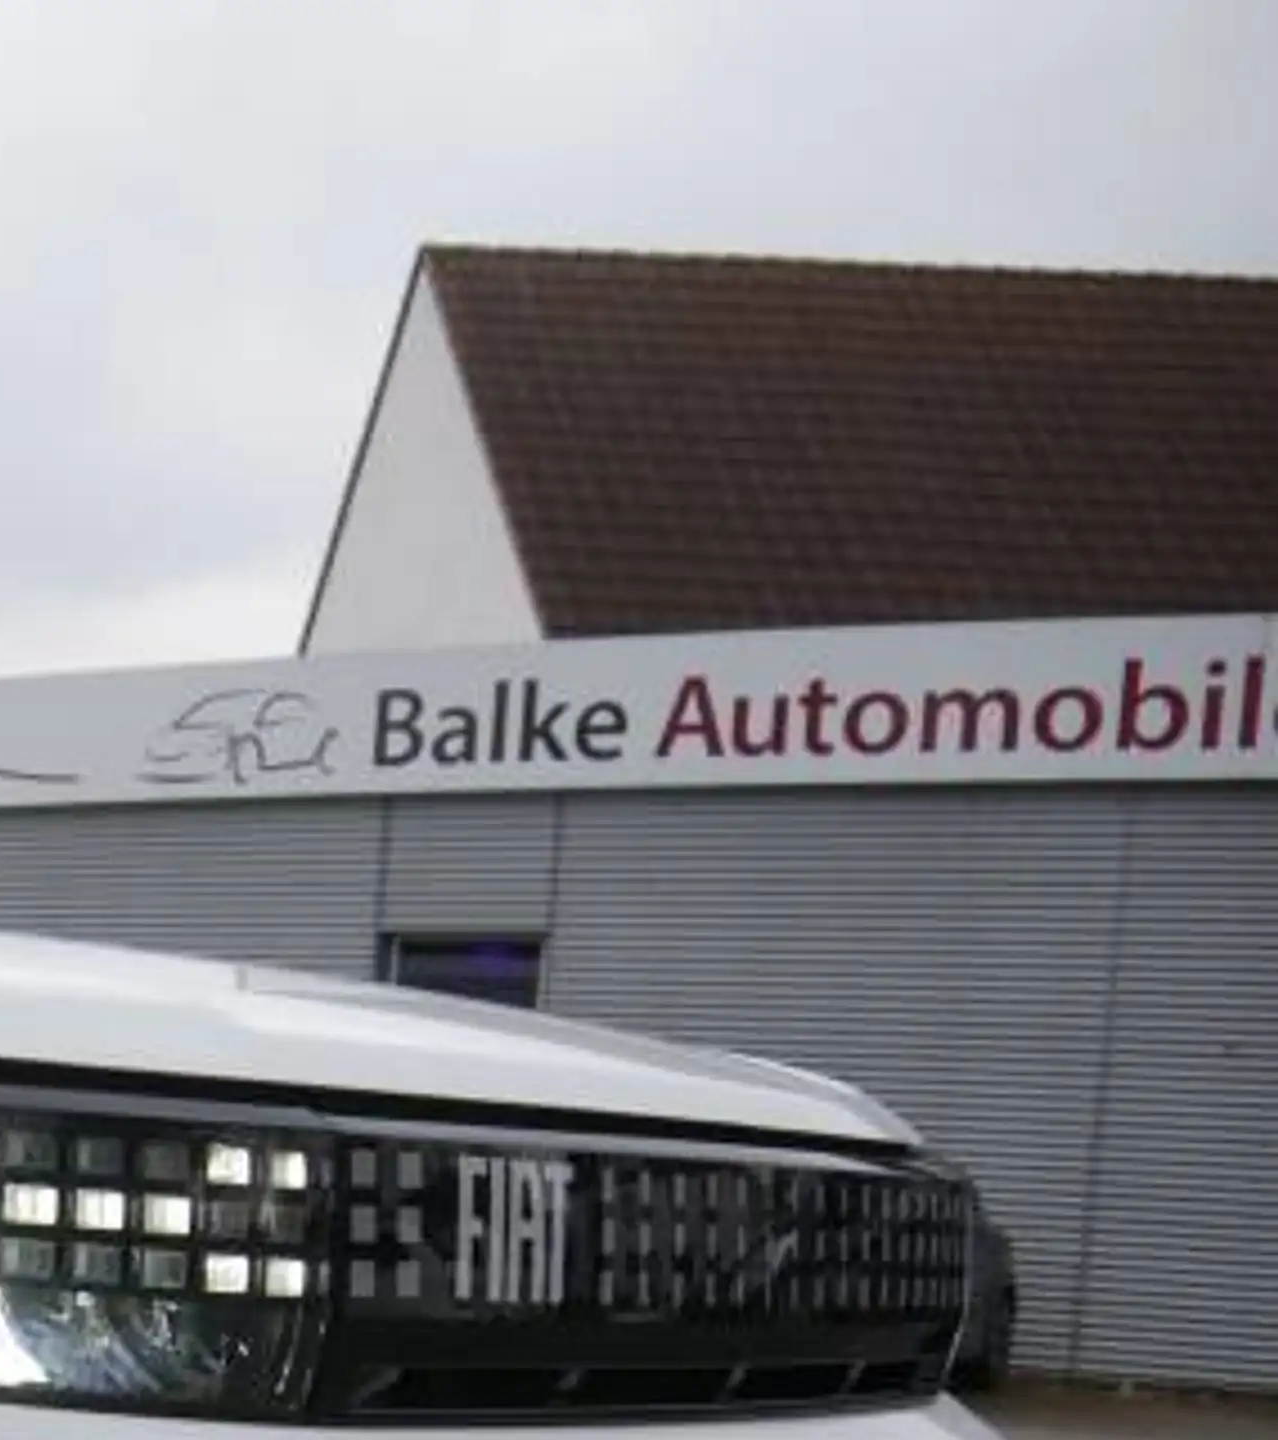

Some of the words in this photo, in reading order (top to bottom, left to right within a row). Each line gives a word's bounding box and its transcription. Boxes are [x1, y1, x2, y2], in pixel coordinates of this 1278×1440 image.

[372, 679, 629, 767] Balke
[656, 655, 1278, 759] Automobil
[455, 1154, 574, 1306] FIAT
